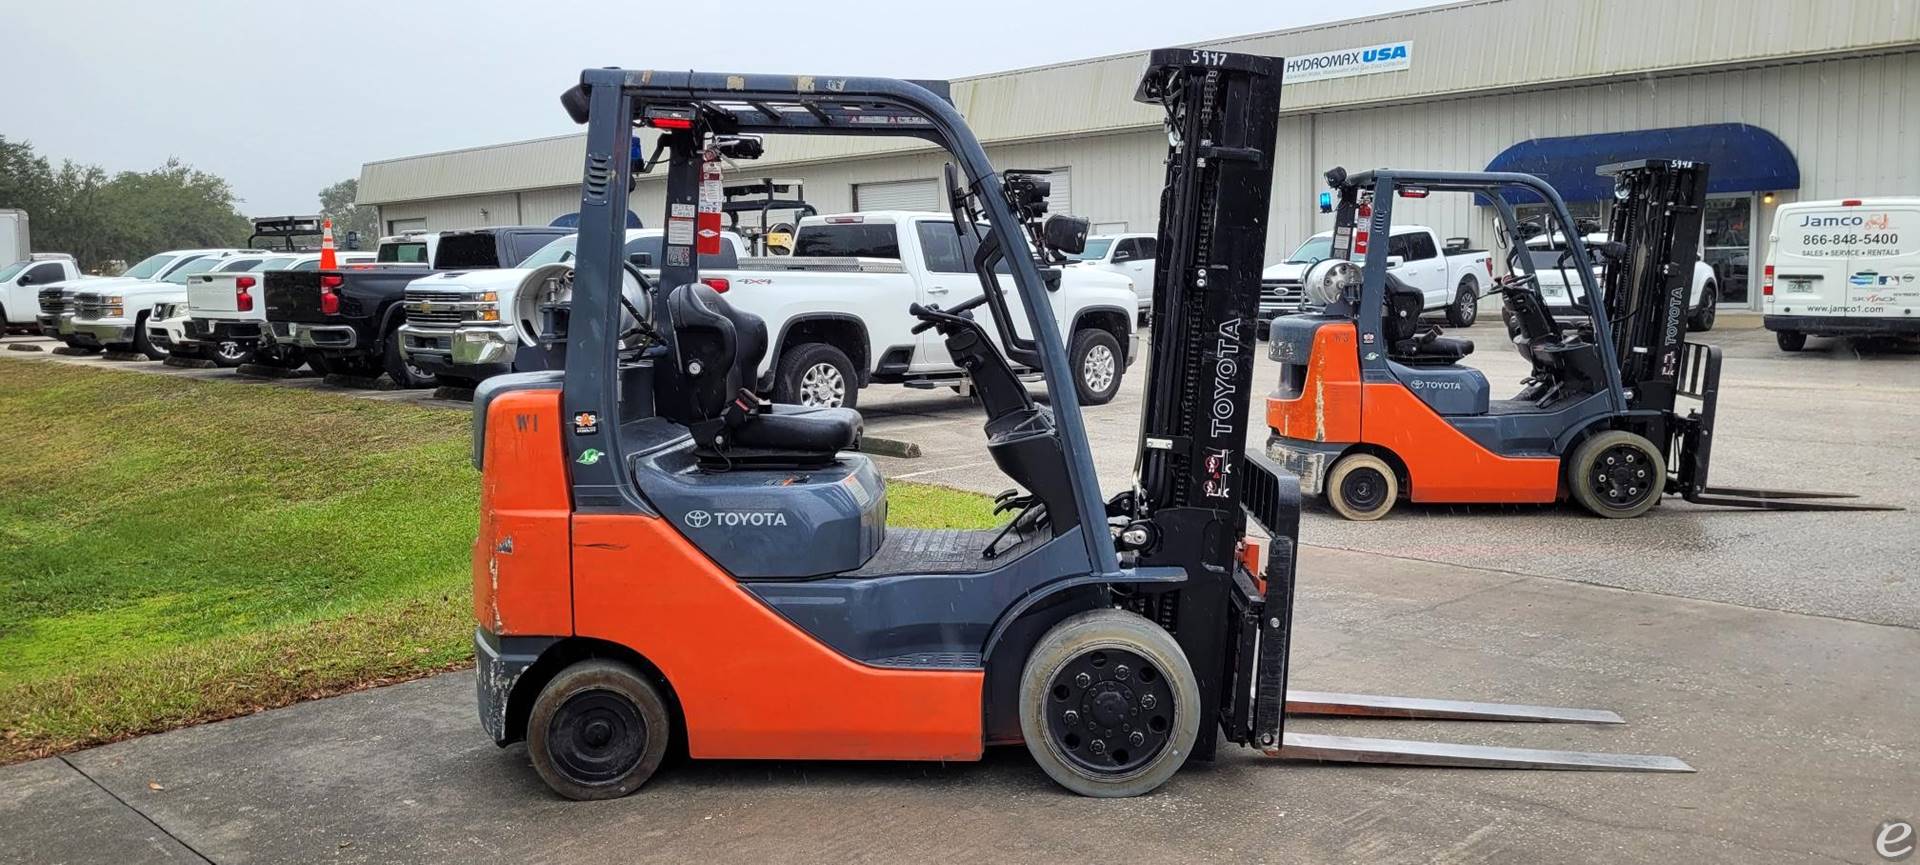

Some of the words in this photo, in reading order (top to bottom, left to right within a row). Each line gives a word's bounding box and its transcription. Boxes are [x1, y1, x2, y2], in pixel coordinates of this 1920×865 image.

[1190, 50, 1228, 66] 5947
[1286, 52, 1360, 73] HYDROMAX
[1362, 45, 1407, 63] USA
[1800, 215, 1864, 228] Jamco
[1803, 233, 1899, 246] 866-848-5400
[1802, 249, 1824, 257] SALES
[1830, 249, 1860, 257] SERVICE
[1867, 249, 1900, 257] RENTALS
[1664, 286, 1684, 346] TOYOTA
[1807, 305, 1885, 314] www.jamco1.com
[1210, 317, 1241, 438] TOYOTA
[1425, 382, 1461, 390] TOYOTA
[575, 412, 597, 427] SAS
[714, 512, 787, 526] TOYOTA
